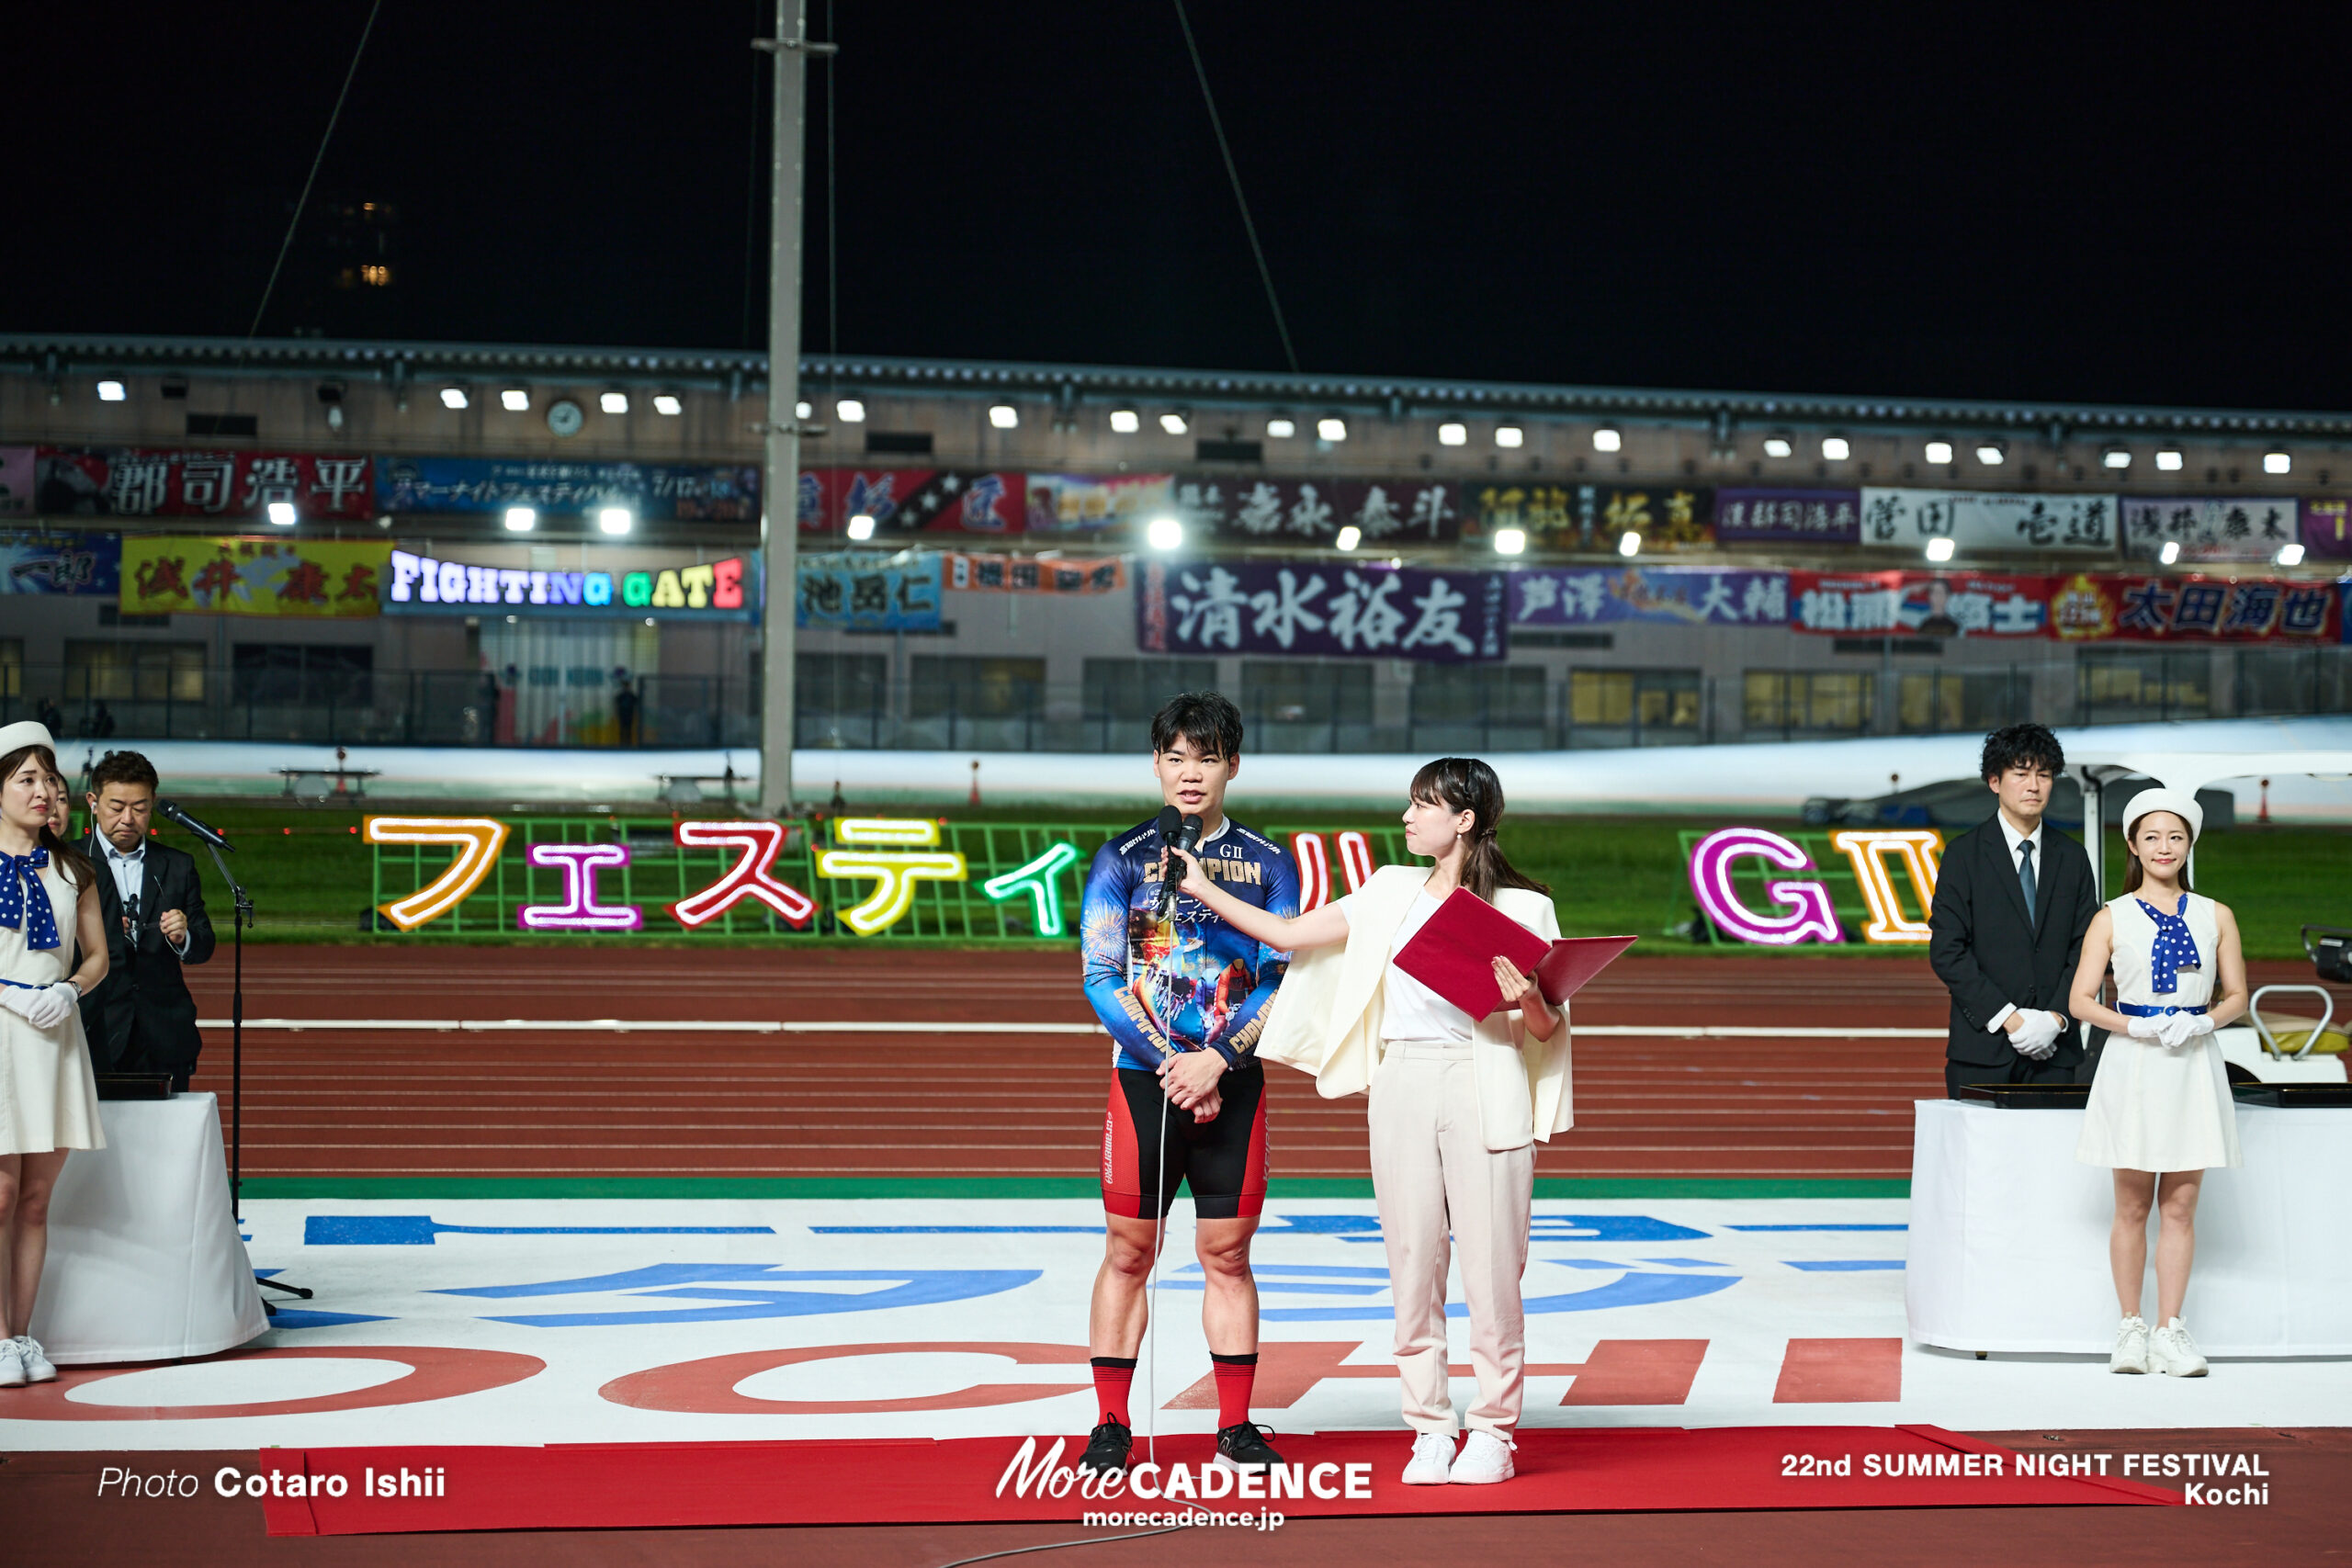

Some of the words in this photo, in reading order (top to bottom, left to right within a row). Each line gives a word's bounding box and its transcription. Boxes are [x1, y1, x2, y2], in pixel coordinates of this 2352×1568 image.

[112, 455, 368, 515] 郡司浩平
[1231, 481, 1456, 538] 嘉永泰斗
[390, 550, 613, 606] FIGHTING
[623, 558, 743, 609] GATE
[1170, 565, 1475, 652] 清水裕友
[2118, 580, 2334, 636] 太田海也
[1143, 857, 1261, 886] CPION
